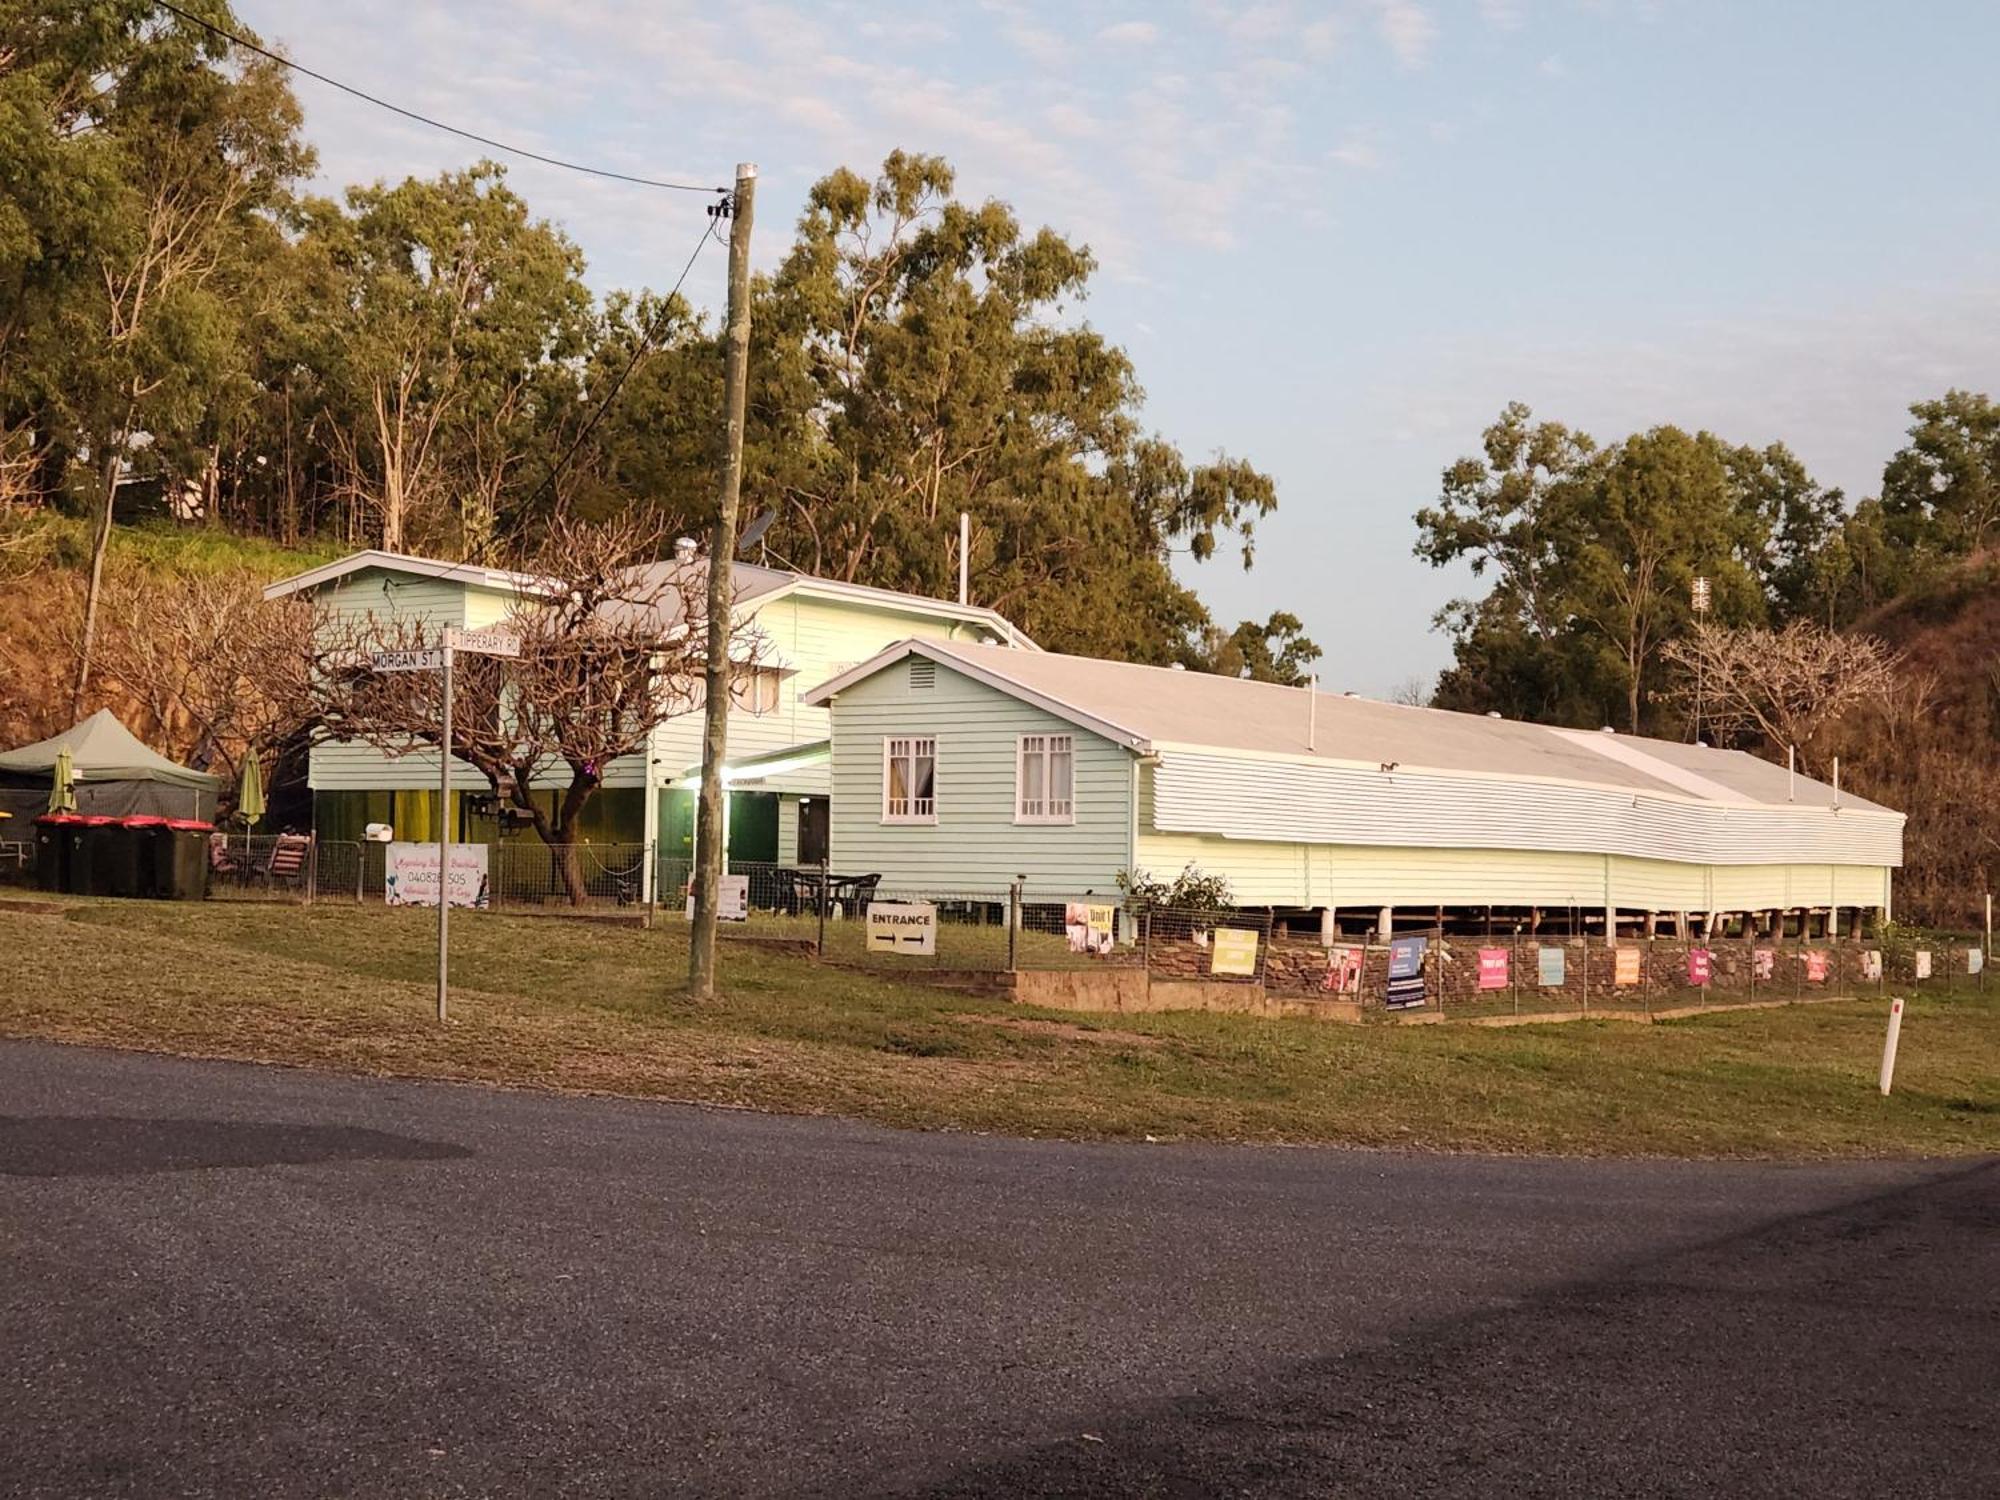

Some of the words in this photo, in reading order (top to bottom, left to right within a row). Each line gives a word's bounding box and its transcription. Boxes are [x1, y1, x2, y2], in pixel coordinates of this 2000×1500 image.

[460, 632, 503, 649] TIPPERARY
[507, 637, 518, 652] RD
[373, 651, 417, 668] MORGAN
[422, 651, 434, 666] ST
[872, 914, 930, 925] ENTRANCE
